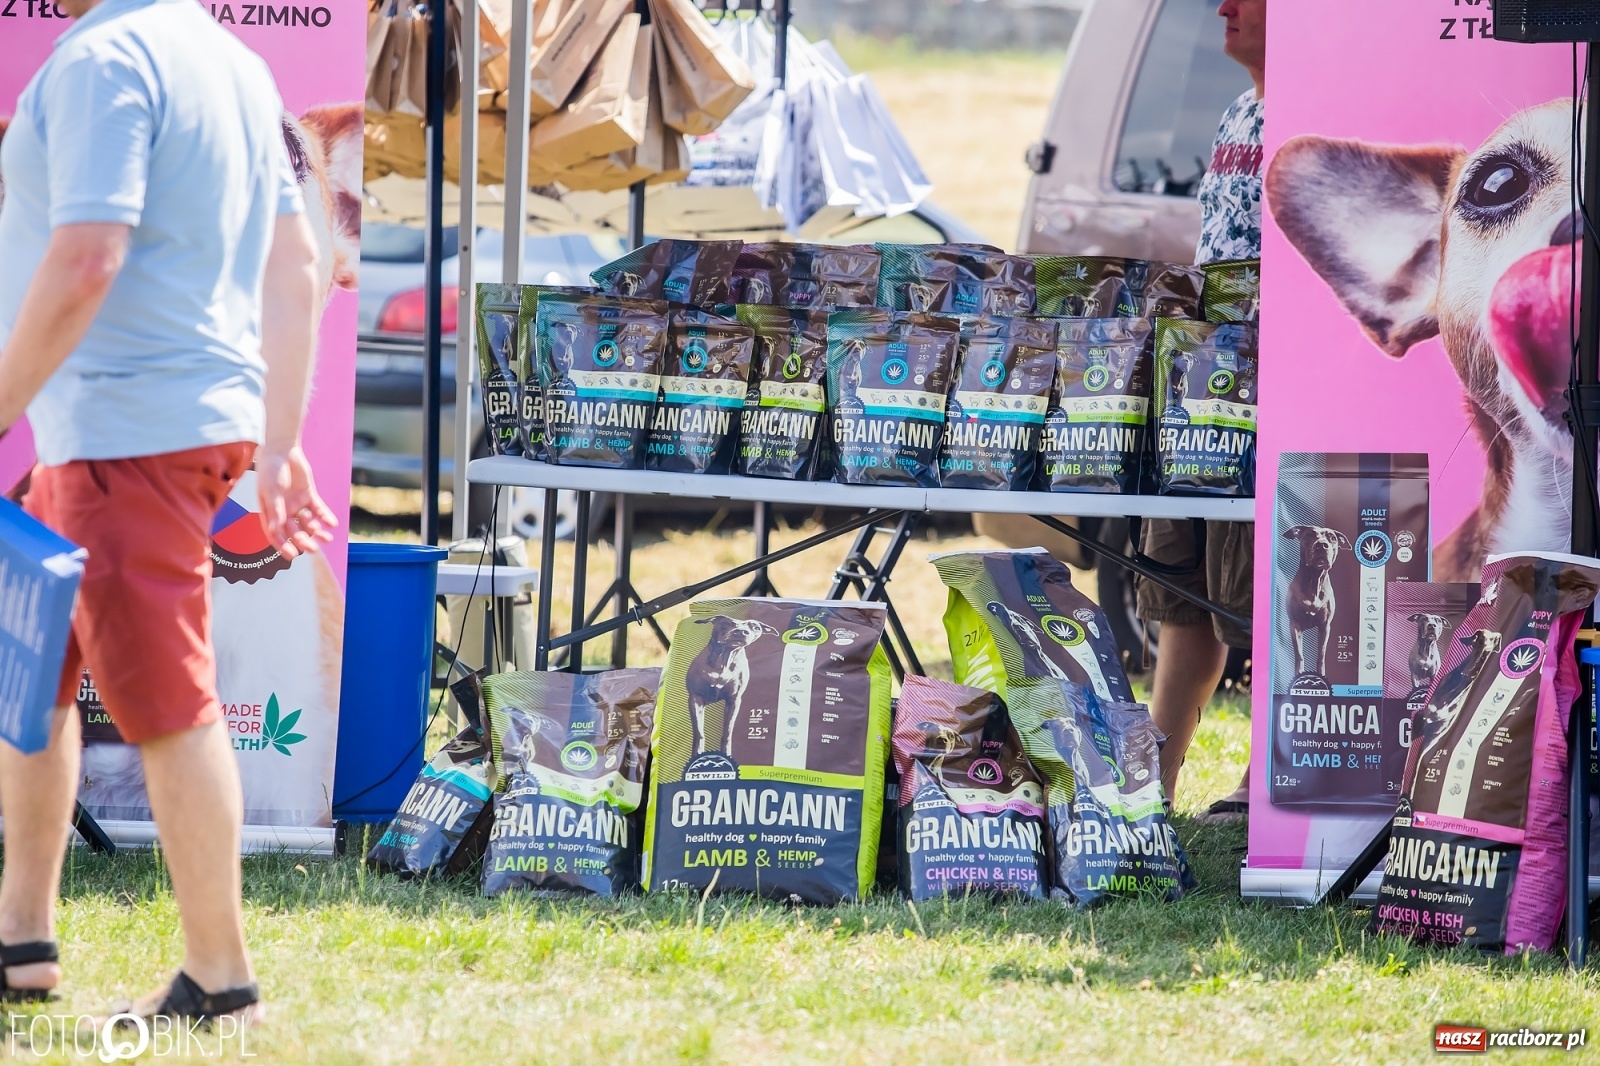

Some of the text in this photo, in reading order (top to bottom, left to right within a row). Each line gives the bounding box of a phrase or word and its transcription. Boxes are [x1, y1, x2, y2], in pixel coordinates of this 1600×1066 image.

[241, 4, 332, 28] ZIMNO
[1440, 18, 1457, 39] Z
[663, 280, 688, 290] ADULT
[789, 292, 812, 301] PUPPY
[955, 294, 979, 303] ADULT
[1117, 303, 1140, 312] ADULT
[546, 399, 646, 430] GRANCANN
[1086, 413, 1125, 421] Superpremium
[1209, 416, 1248, 427] Superpremium
[553, 426, 632, 438] healthy dog happy family
[834, 418, 935, 449] GRANCANN
[553, 436, 631, 450] LAMB & HEMP
[661, 434, 715, 445] dog happy family
[767, 438, 782, 446] happy
[1039, 426, 1135, 453] GRANCANN
[678, 444, 714, 456] & HEMP
[764, 447, 797, 459] & HEMP
[839, 445, 918, 457] healthy dog happy family
[978, 451, 996, 459] happy
[996, 451, 1015, 460] family
[841, 454, 917, 468] LAMB & HEMP
[941, 458, 1014, 471] LAMB & HEMP
[1046, 454, 1122, 463] healthy dog happy family
[1046, 463, 1122, 476] LAMB & HEMP
[1164, 463, 1213, 476] LAMB &
[1361, 508, 1387, 516] ADULT
[209, 552, 233, 568] olejem
[238, 558, 264, 570] konopi
[1026, 594, 1047, 602] ADULT
[1531, 610, 1553, 620] PUPPY
[1337, 635, 1353, 644] 12%
[1337, 651, 1353, 660] 25%
[607, 711, 622, 721] 12%
[750, 708, 770, 718] 12%
[571, 721, 595, 729] ADULT
[607, 728, 624, 738] 25%
[748, 727, 769, 737] 25%
[982, 740, 1004, 748] PUPPY
[1292, 738, 1375, 749] healthy dog happy
[1292, 752, 1360, 769] LAMB &
[1488, 755, 1505, 763] DENTAL
[759, 769, 823, 784] Superpremium
[1275, 775, 1289, 786] 12
[1387, 782, 1394, 790] 3
[671, 788, 846, 832] GRANCANN
[489, 803, 628, 849] GRANCANN
[1425, 817, 1479, 834] Superpremium
[390, 832, 399, 847] &
[399, 833, 418, 845] HEMP
[685, 832, 827, 847] healthy dog happy family
[498, 840, 610, 856] healthy dog happy family
[684, 848, 817, 867] LAMB & HEMP
[924, 853, 957, 864] healthy
[958, 853, 975, 864] dog
[988, 853, 1015, 863] happy
[494, 856, 606, 873] LAMB & HEMP
[1086, 858, 1163, 870] healthy dog happy
[926, 867, 1038, 881] CHICKEN & FISH
[928, 881, 1029, 891] with SEEDS
[1086, 875, 1137, 891] LAMB
[1396, 886, 1475, 906] dog happy family
[1378, 904, 1464, 928] CHICKEN & FISH
[1430, 928, 1462, 944] SEEDS
